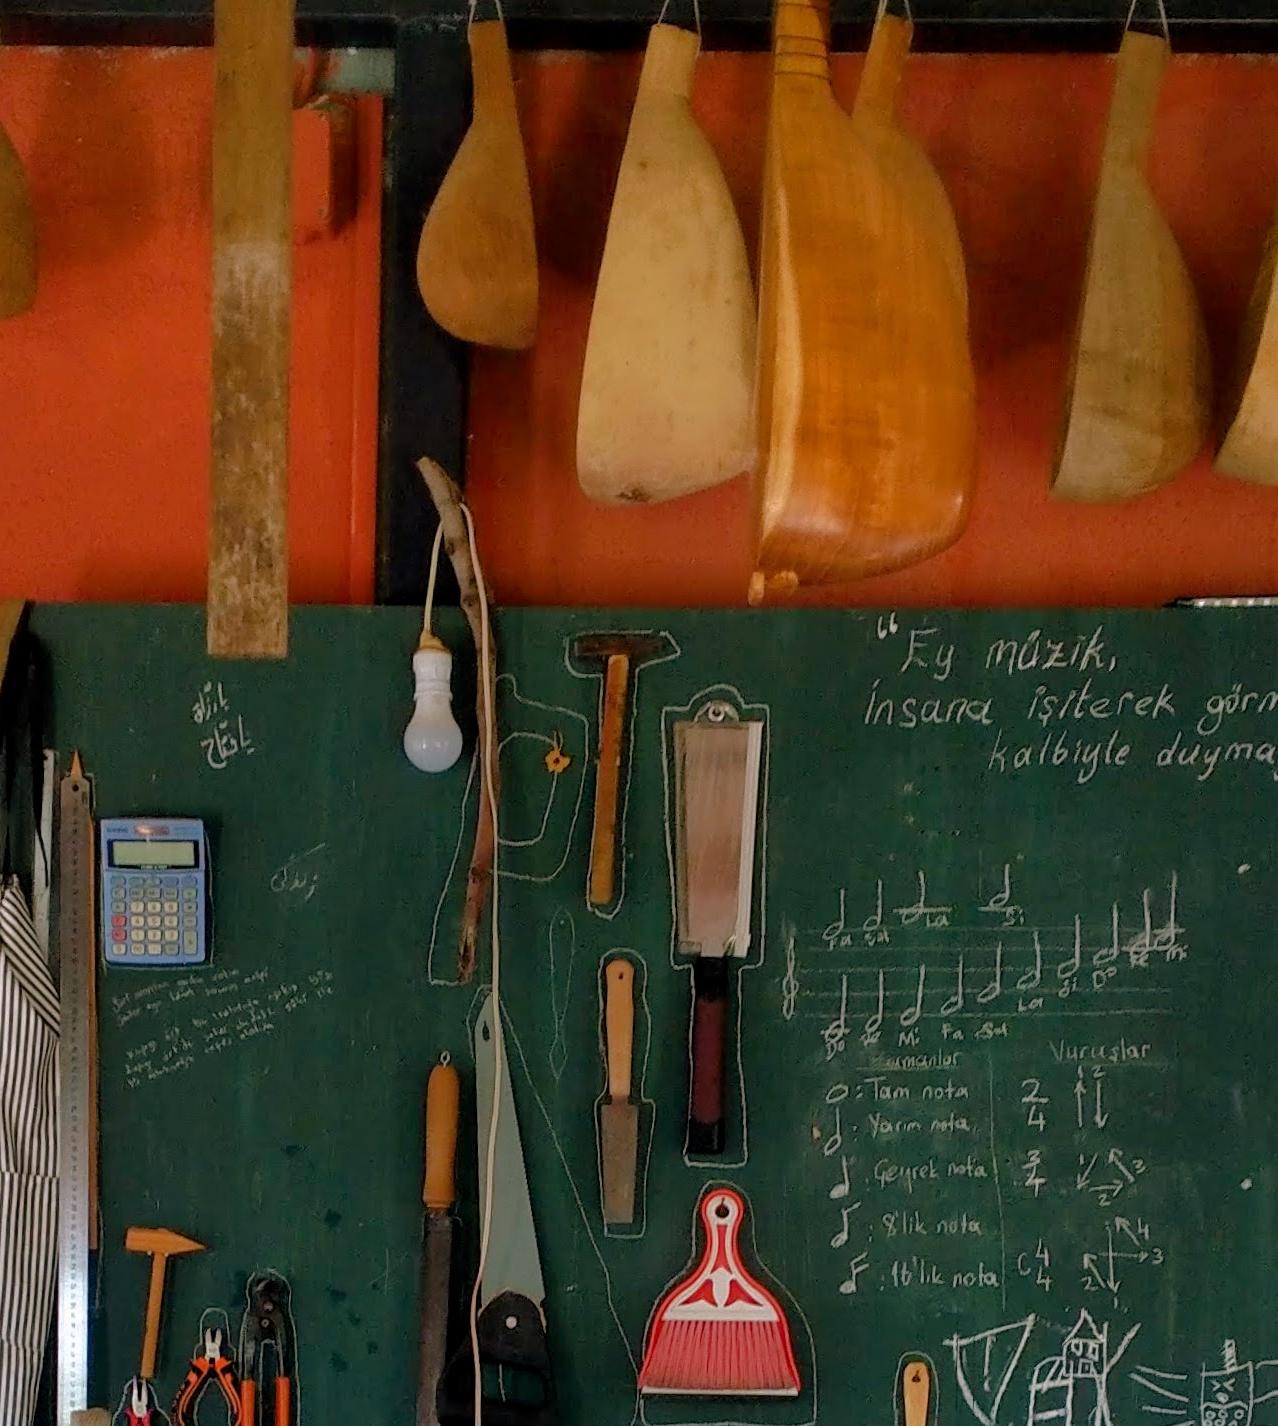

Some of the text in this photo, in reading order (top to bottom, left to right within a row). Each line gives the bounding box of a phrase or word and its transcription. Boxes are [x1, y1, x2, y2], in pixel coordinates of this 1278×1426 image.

[1027, 677, 1176, 728] işiterek
[987, 727, 1129, 784] kalbiyle
[863, 1075, 971, 1102] Tam nota
[930, 1112, 972, 1133] nota
[947, 1155, 989, 1178] nota
[936, 1212, 983, 1237] nota
[952, 1261, 1000, 1288] nota
